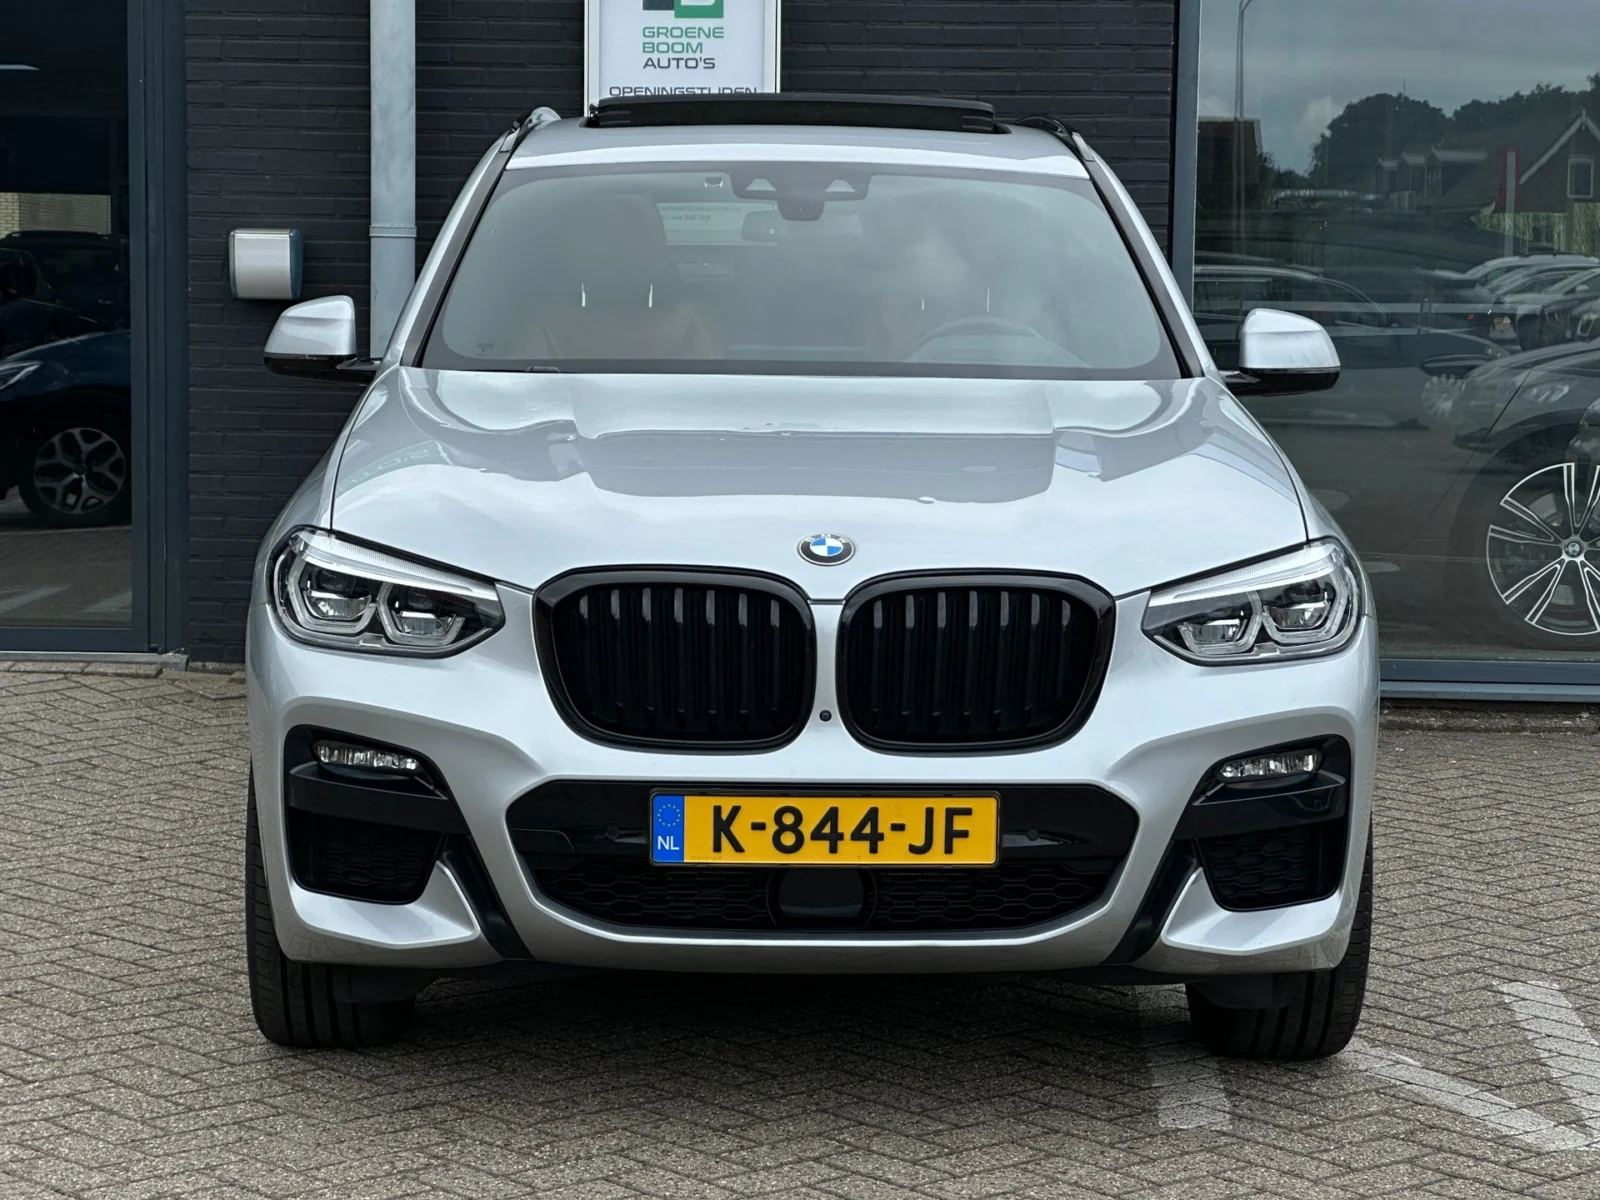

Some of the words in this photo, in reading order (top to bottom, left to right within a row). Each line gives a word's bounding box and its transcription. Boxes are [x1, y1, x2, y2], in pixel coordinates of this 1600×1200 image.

[642, 26, 724, 38] GROENE
[642, 42, 703, 54] BOOM
[643, 57, 716, 69] AUTO'S
[712, 804, 973, 855] K-844-JF
[657, 836, 680, 851] NL
